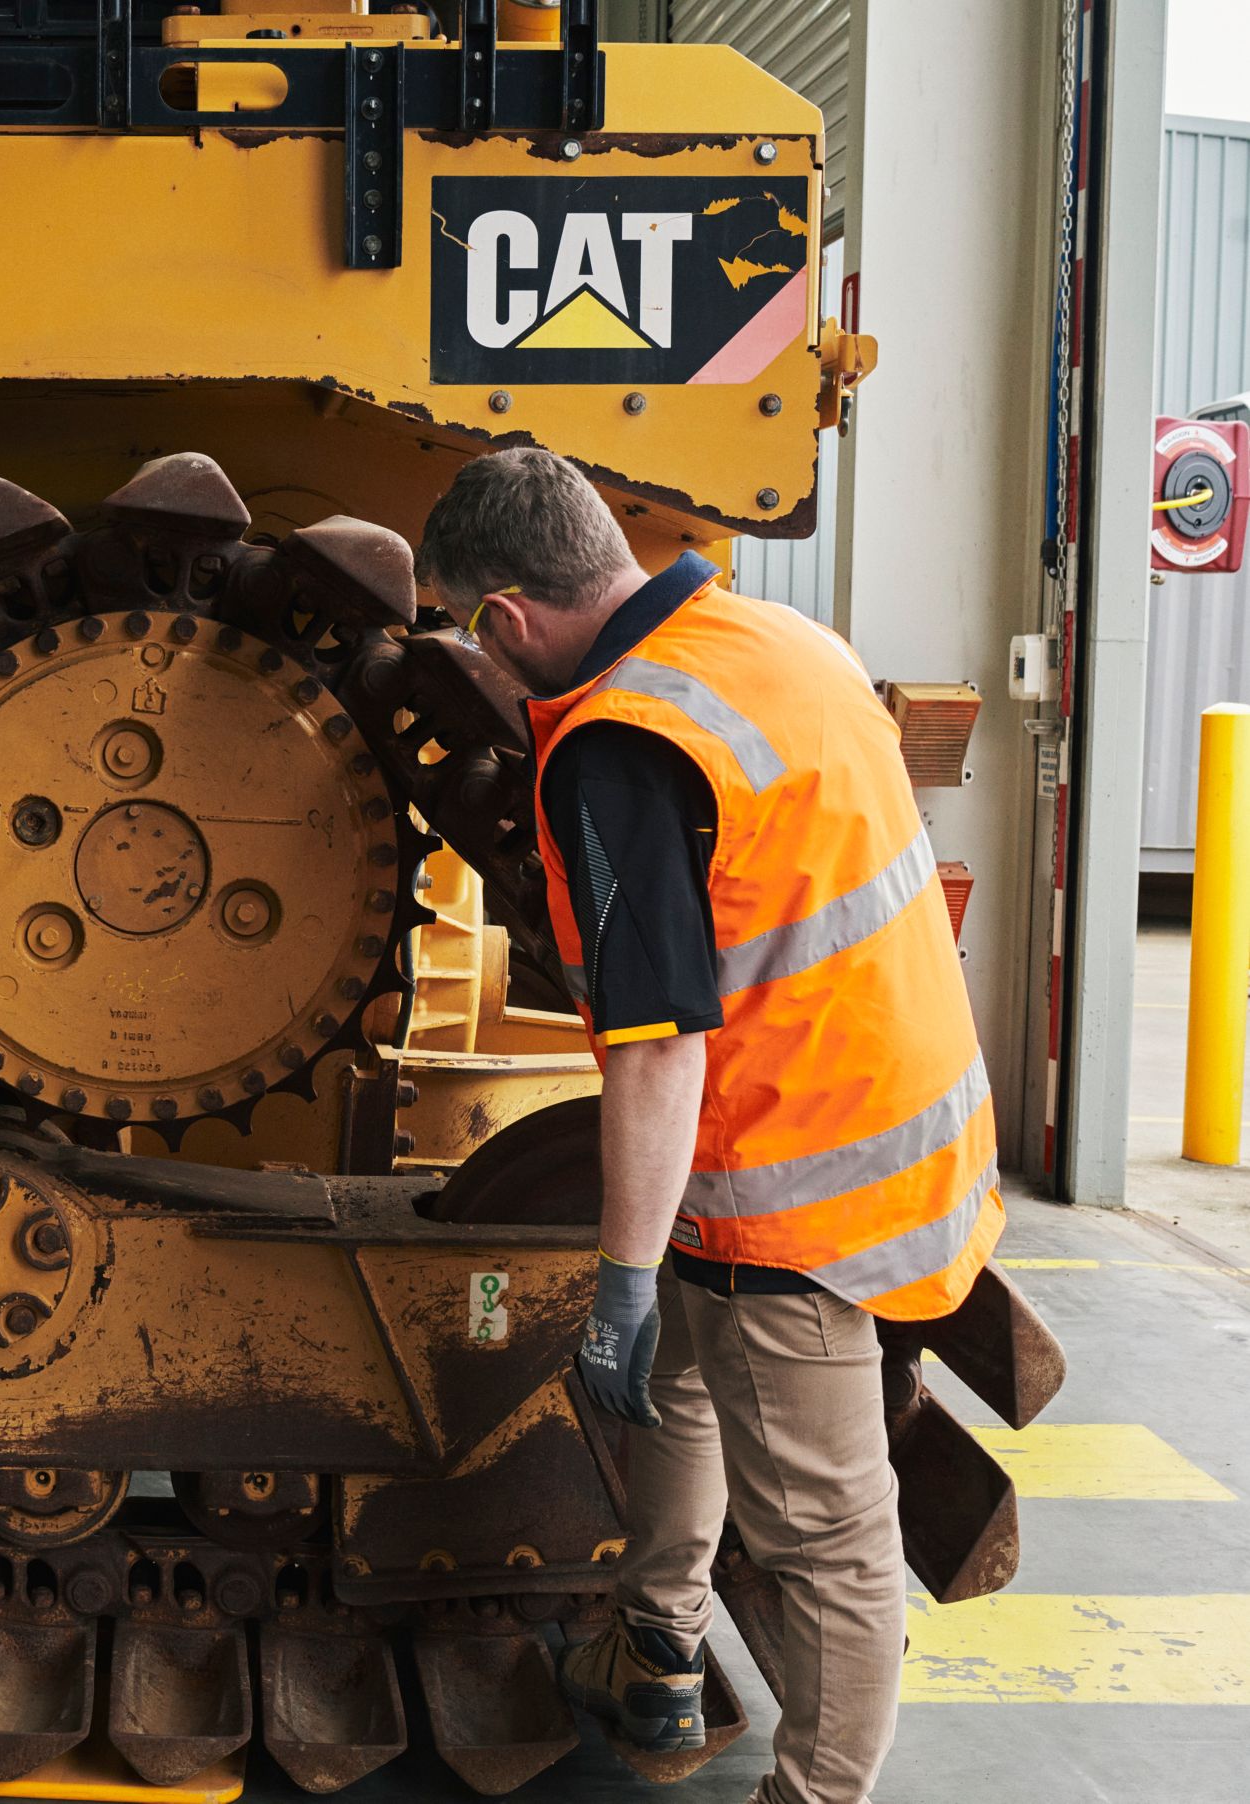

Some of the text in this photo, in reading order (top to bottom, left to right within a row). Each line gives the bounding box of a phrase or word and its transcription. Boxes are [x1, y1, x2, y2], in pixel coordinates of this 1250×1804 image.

[466, 210, 693, 349] CAT
[580, 1347, 618, 1371] MaxiFlex
[679, 1717, 693, 1728] CAT
